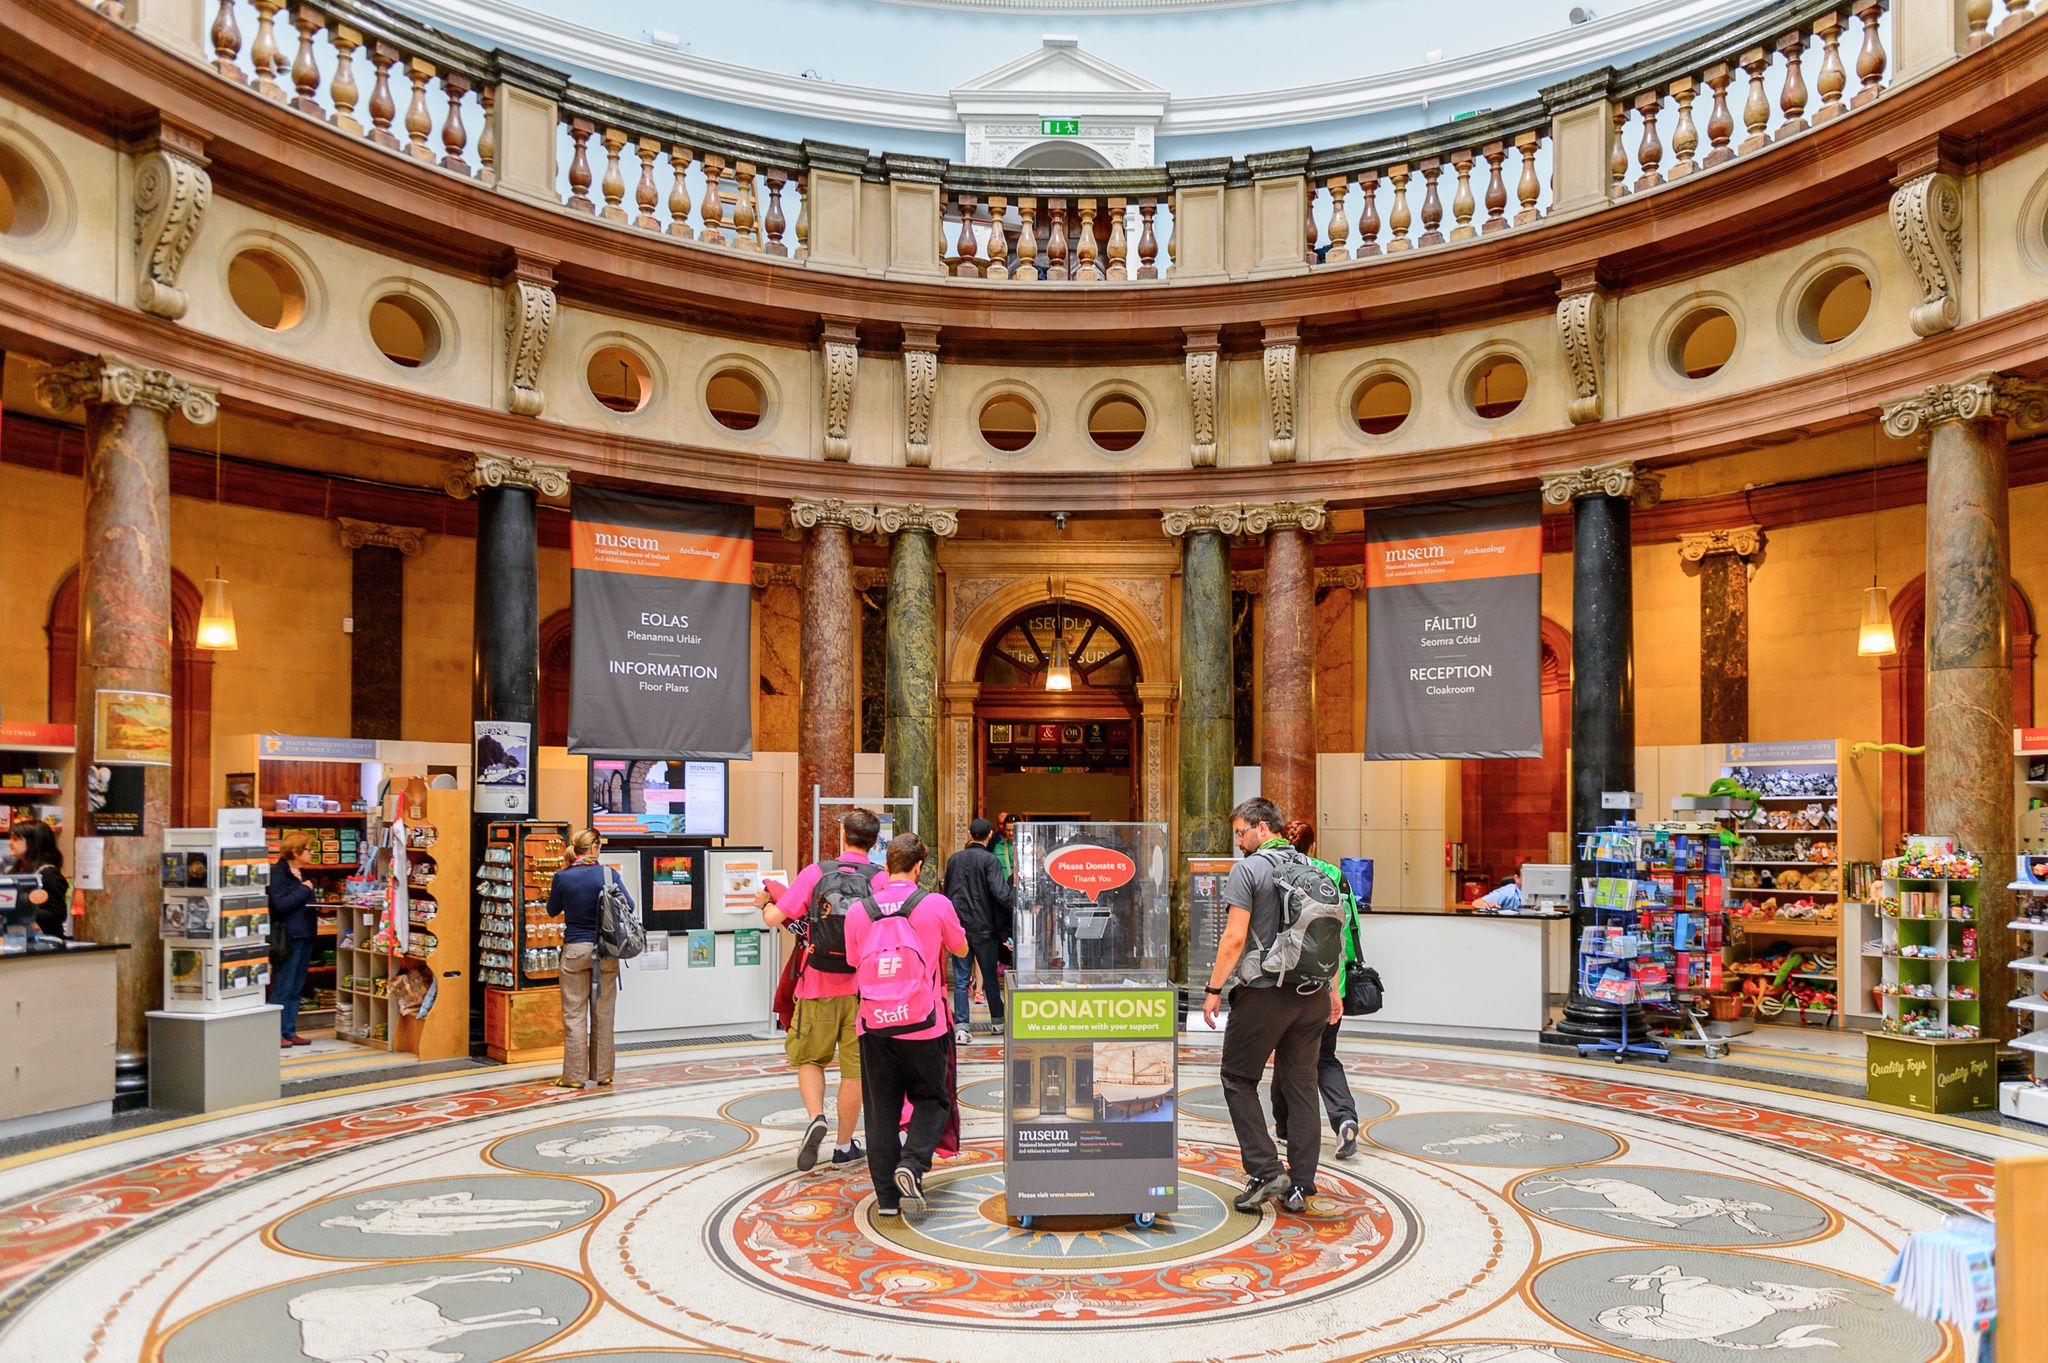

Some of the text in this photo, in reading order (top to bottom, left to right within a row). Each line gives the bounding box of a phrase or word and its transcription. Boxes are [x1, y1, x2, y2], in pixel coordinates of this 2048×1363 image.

[594, 532, 720, 559] museum Archaeology
[594, 548, 619, 556] National
[1386, 545, 1506, 562] museum Archaeology
[1436, 558, 1455, 566] Ireland
[641, 612, 689, 628] EOLAS
[1424, 613, 1477, 632] FÁILTIÚ
[627, 630, 702, 644] Pleananna Urláir
[1421, 634, 1481, 647] Seomra Cótaí
[609, 660, 718, 680] INFORMATION
[1409, 664, 1493, 681] RECEPTION
[639, 681, 689, 693] Floor Plans
[1426, 685, 1475, 695] Cloakroom
[1058, 862, 1127, 871] Please Donate €5
[1073, 875, 1112, 883] Thank You
[877, 957, 902, 975] EF
[873, 1004, 909, 1024] Staff
[1020, 999, 1167, 1019] DONATIONS
[1027, 1023, 1041, 1031] We
[1057, 1023, 1068, 1031] do
[1090, 1023, 1108, 1031] with
[1109, 1024, 1128, 1032] your
[1129, 1023, 1159, 1032] support
[1870, 1058, 1927, 1078] Quality Toys
[1937, 1059, 1988, 1088] Quality Toys
[1019, 1129, 1069, 1141] museum
